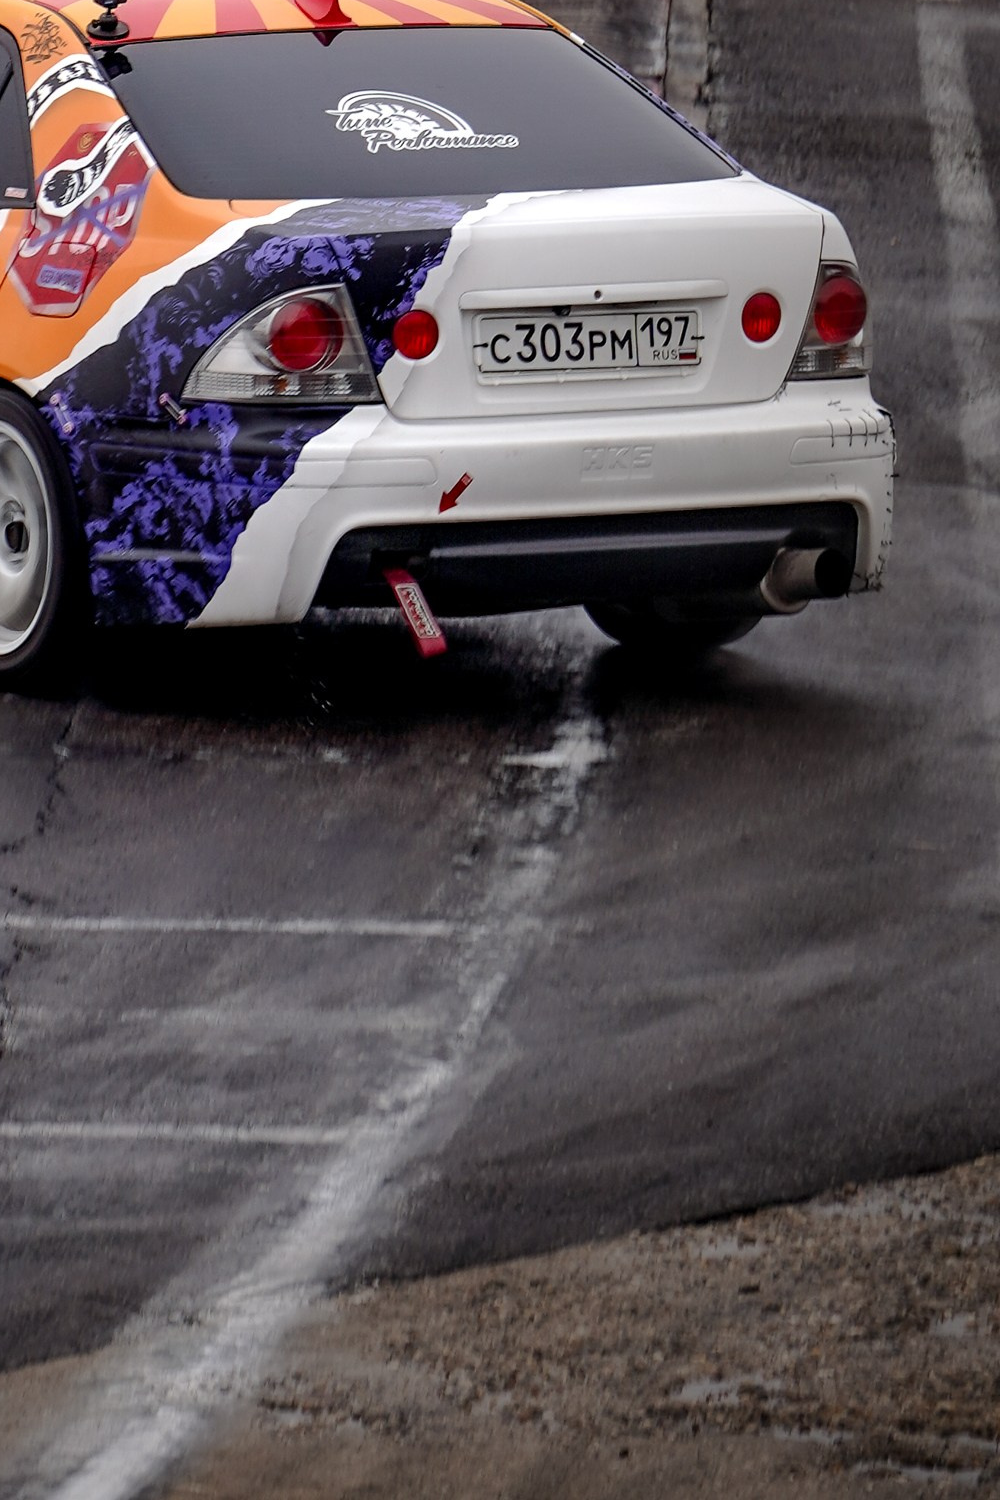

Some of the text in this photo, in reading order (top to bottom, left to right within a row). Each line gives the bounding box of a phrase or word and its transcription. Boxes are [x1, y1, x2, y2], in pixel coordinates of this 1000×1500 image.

[325, 104, 394, 132] Tune
[361, 129, 519, 154] Performance
[639, 316, 690, 348] 197
[652, 350, 678, 361] RUS
